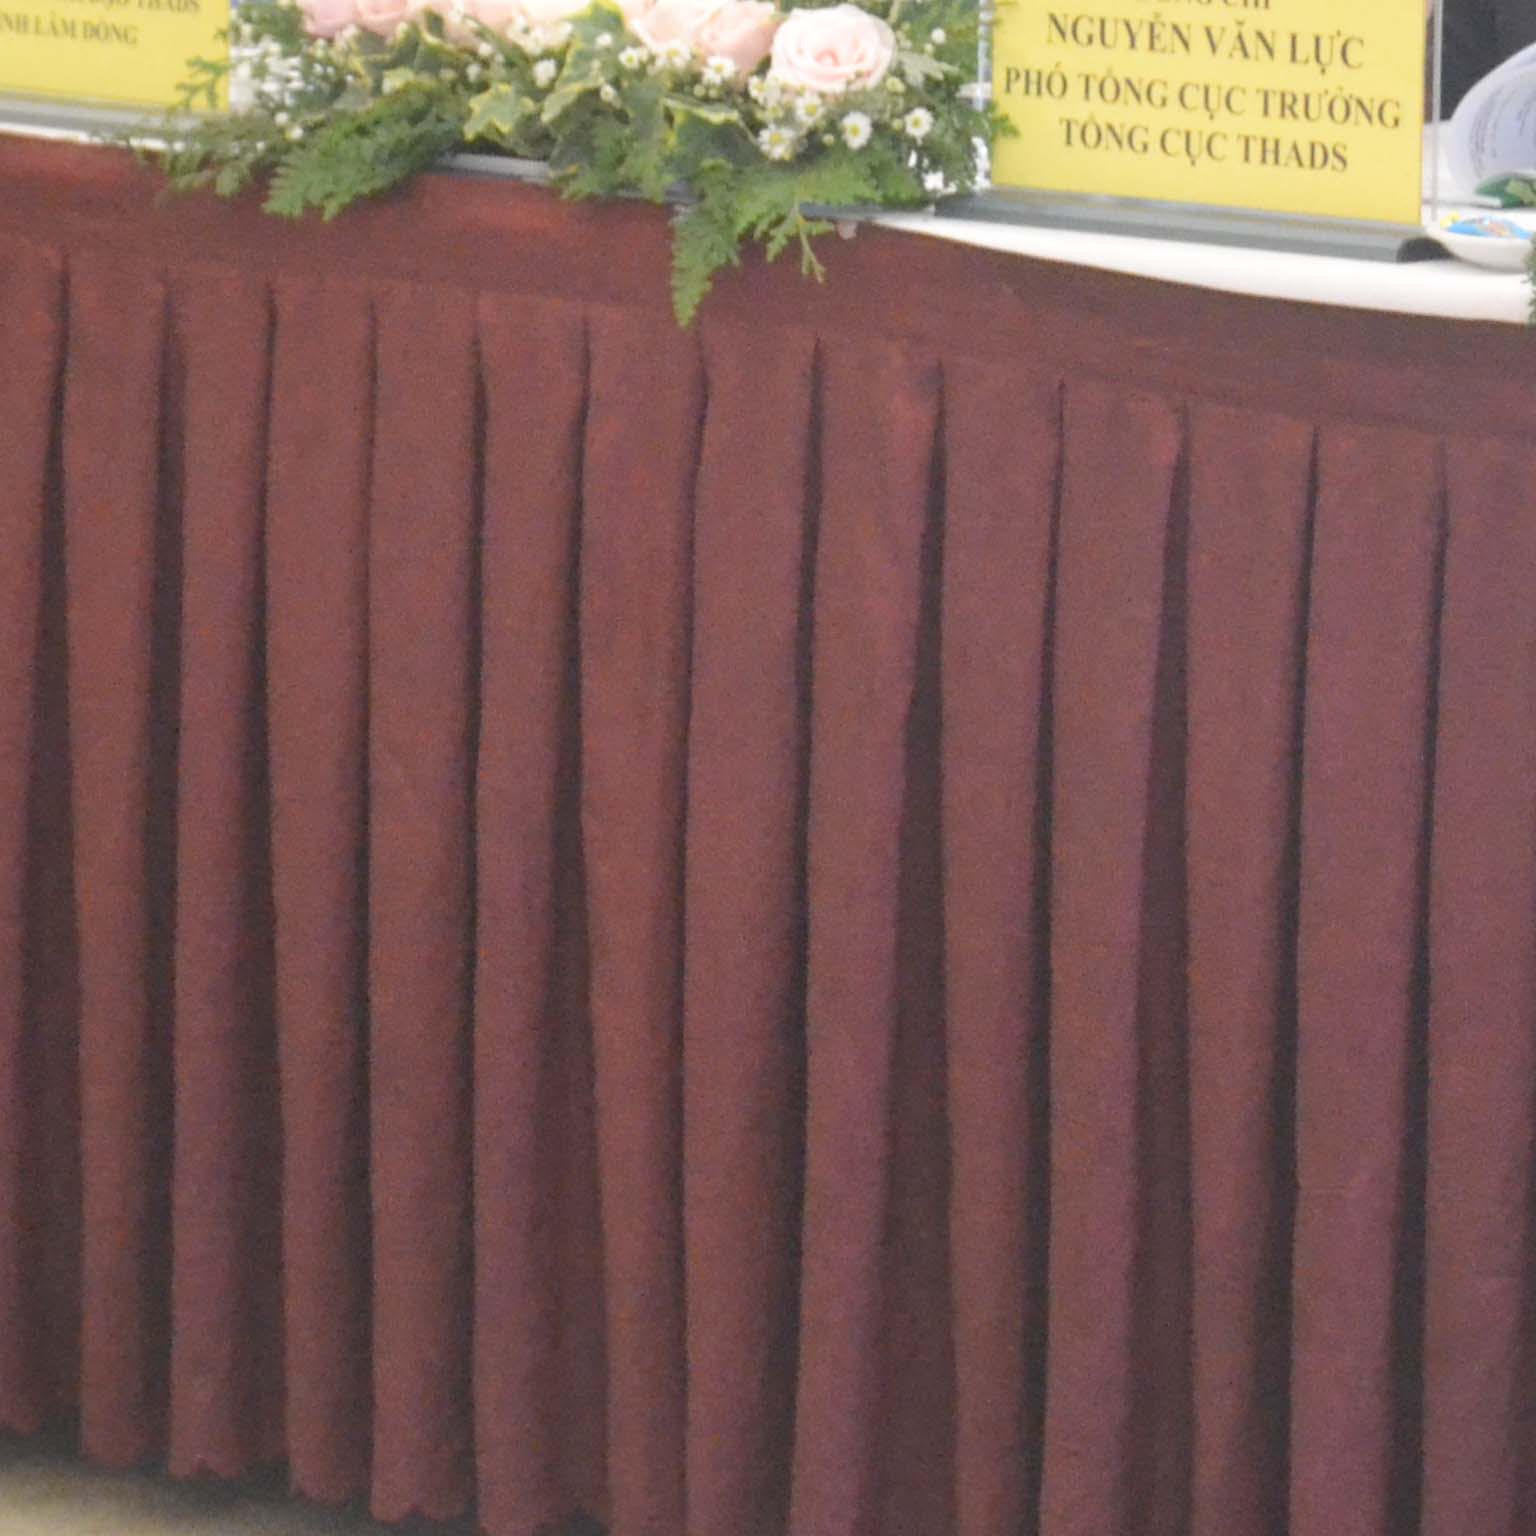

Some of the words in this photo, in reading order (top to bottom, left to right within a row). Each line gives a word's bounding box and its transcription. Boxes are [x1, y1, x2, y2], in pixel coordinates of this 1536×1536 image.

[34, 11, 77, 40] LÂM
[82, 19, 139, 46] ĐỒNG
[1047, 10, 1192, 56] NGUYỄN
[1203, 20, 1277, 63] VĂN
[1288, 29, 1365, 76] LỰC
[1003, 62, 1068, 101] PHÓ
[1077, 68, 1168, 110] TỔNG
[1178, 81, 1248, 121] CỤC
[1256, 86, 1402, 131] TRƯỞNG
[1060, 114, 1149, 155] TỔNG
[1159, 126, 1229, 167] CỤC
[1237, 133, 1349, 174] THADS
